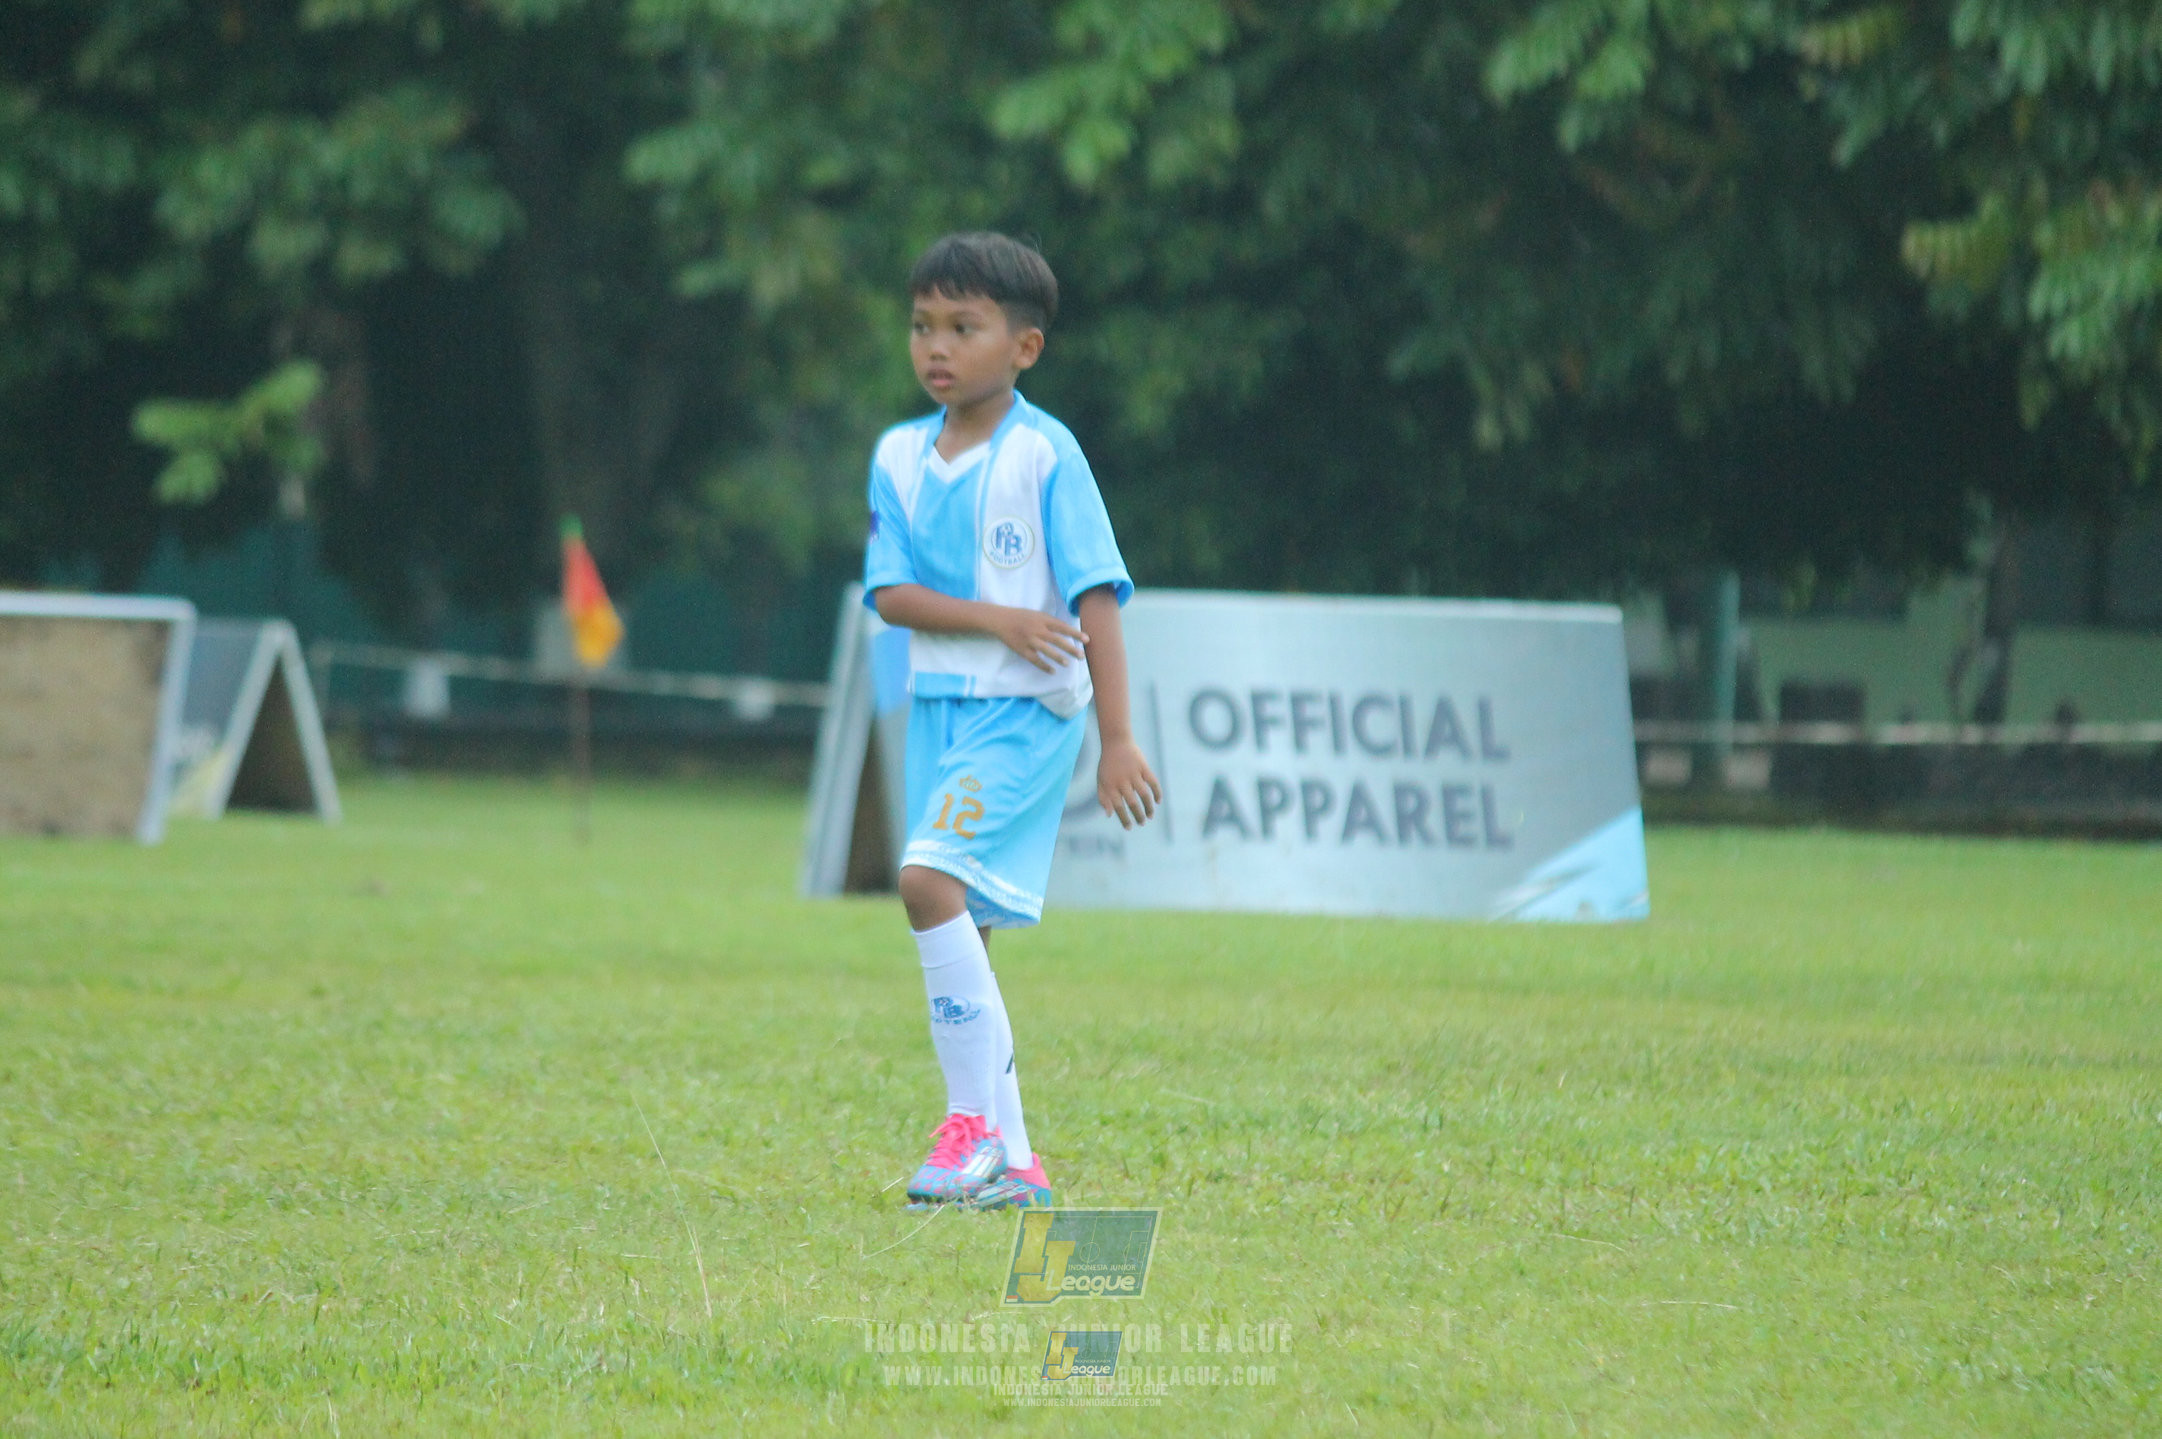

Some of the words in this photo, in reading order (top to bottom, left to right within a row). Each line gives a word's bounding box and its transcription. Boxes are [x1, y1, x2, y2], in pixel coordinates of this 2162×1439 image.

[1188, 688, 1511, 762] OFFICIAL
[932, 793, 985, 840] 12
[1202, 775, 1514, 850] APPAREL
